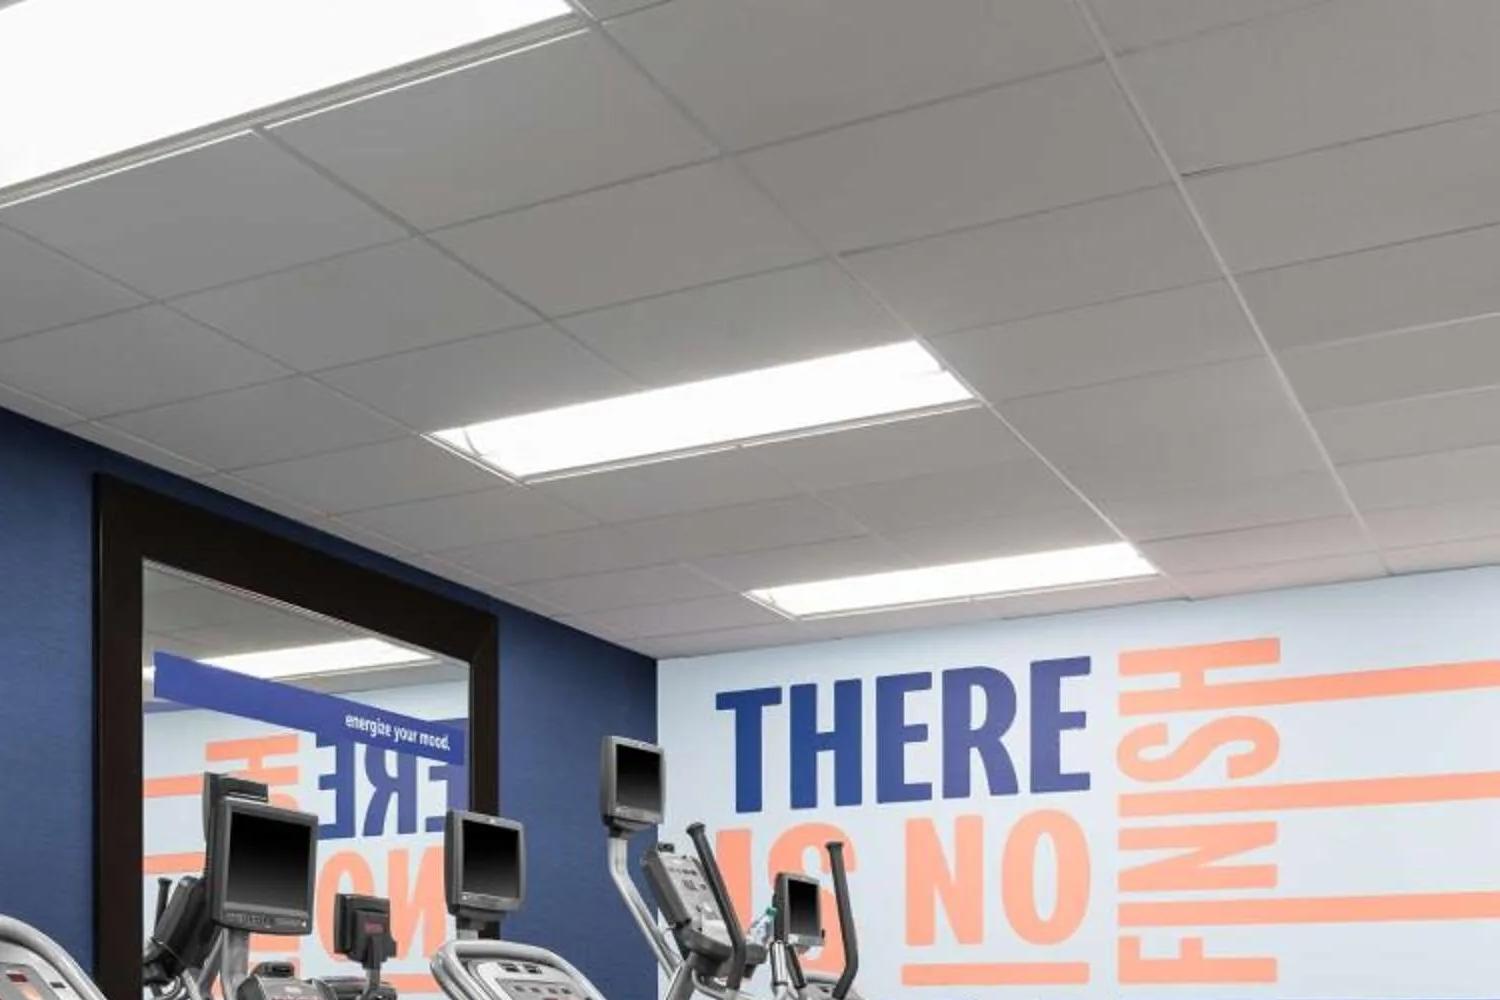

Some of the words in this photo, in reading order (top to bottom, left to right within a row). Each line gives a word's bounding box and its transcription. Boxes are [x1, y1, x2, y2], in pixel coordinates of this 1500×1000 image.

[345, 713, 392, 738] energize
[393, 725, 417, 743] your
[715, 656, 1092, 813] THERE
[904, 808, 1092, 946] NO
[1116, 637, 1282, 985] FINISH
